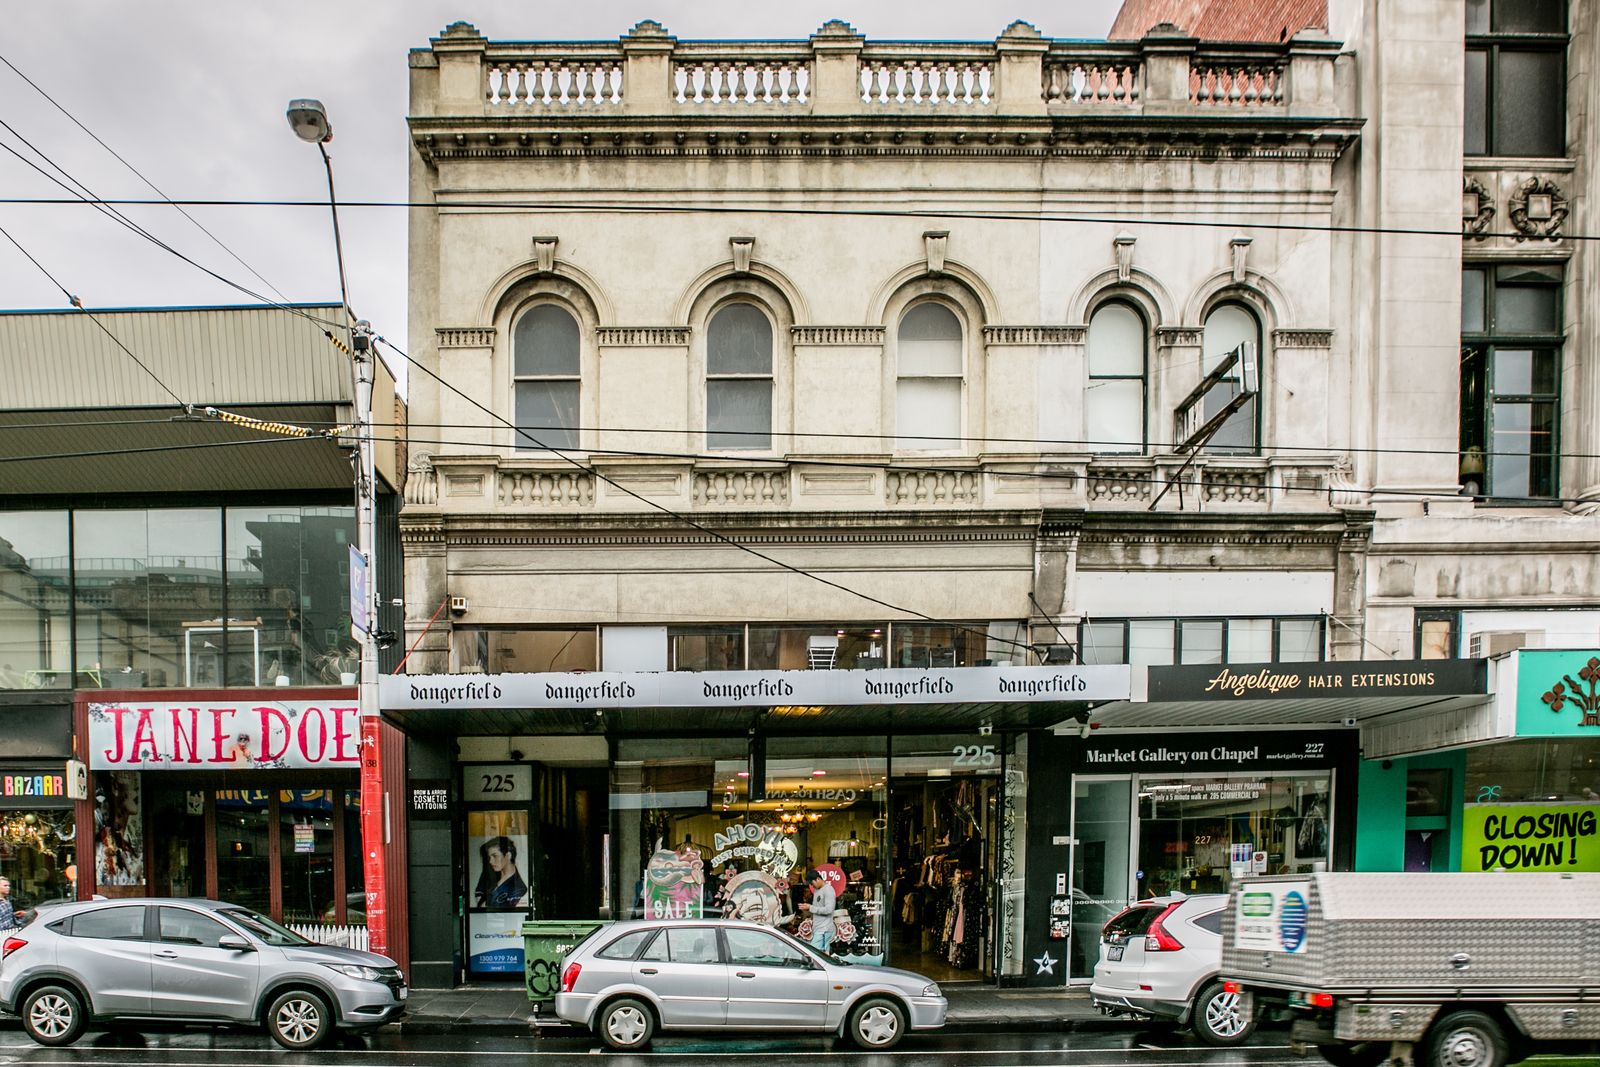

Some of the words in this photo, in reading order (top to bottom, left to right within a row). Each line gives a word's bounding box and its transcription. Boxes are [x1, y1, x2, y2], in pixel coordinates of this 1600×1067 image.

[410, 682, 502, 704] dangerfield
[545, 680, 635, 703] dangerfield
[703, 678, 793, 701] dangerfield
[865, 676, 954, 698] dangerfield
[999, 674, 1087, 696] dangerfield
[1204, 668, 1301, 696] Angelique
[1308, 674, 1343, 688] HAIR
[1351, 672, 1435, 687] EXTENSIONS
[105, 707, 237, 763] JANE
[252, 706, 359, 762] DOE
[952, 745, 995, 767] 225
[1086, 748, 1137, 763] Market
[1139, 748, 1190, 765] Gallery
[1191, 751, 1209, 760] on
[1211, 746, 1259, 763] Chapel
[1304, 743, 1324, 753] 227
[4, 775, 63, 796] BAZAAR
[481, 774, 515, 793] 225
[413, 795, 447, 803] COSMETIC
[414, 802, 448, 810] TATTOOING
[1484, 810, 1597, 840] CLOSING
[714, 823, 784, 851] AHOY!
[1195, 835, 1211, 845] 227
[711, 849, 733, 868] JUST
[733, 846, 774, 860] SHIPPED
[1480, 838, 1578, 871] DOWN!
[654, 896, 694, 919] SALE
